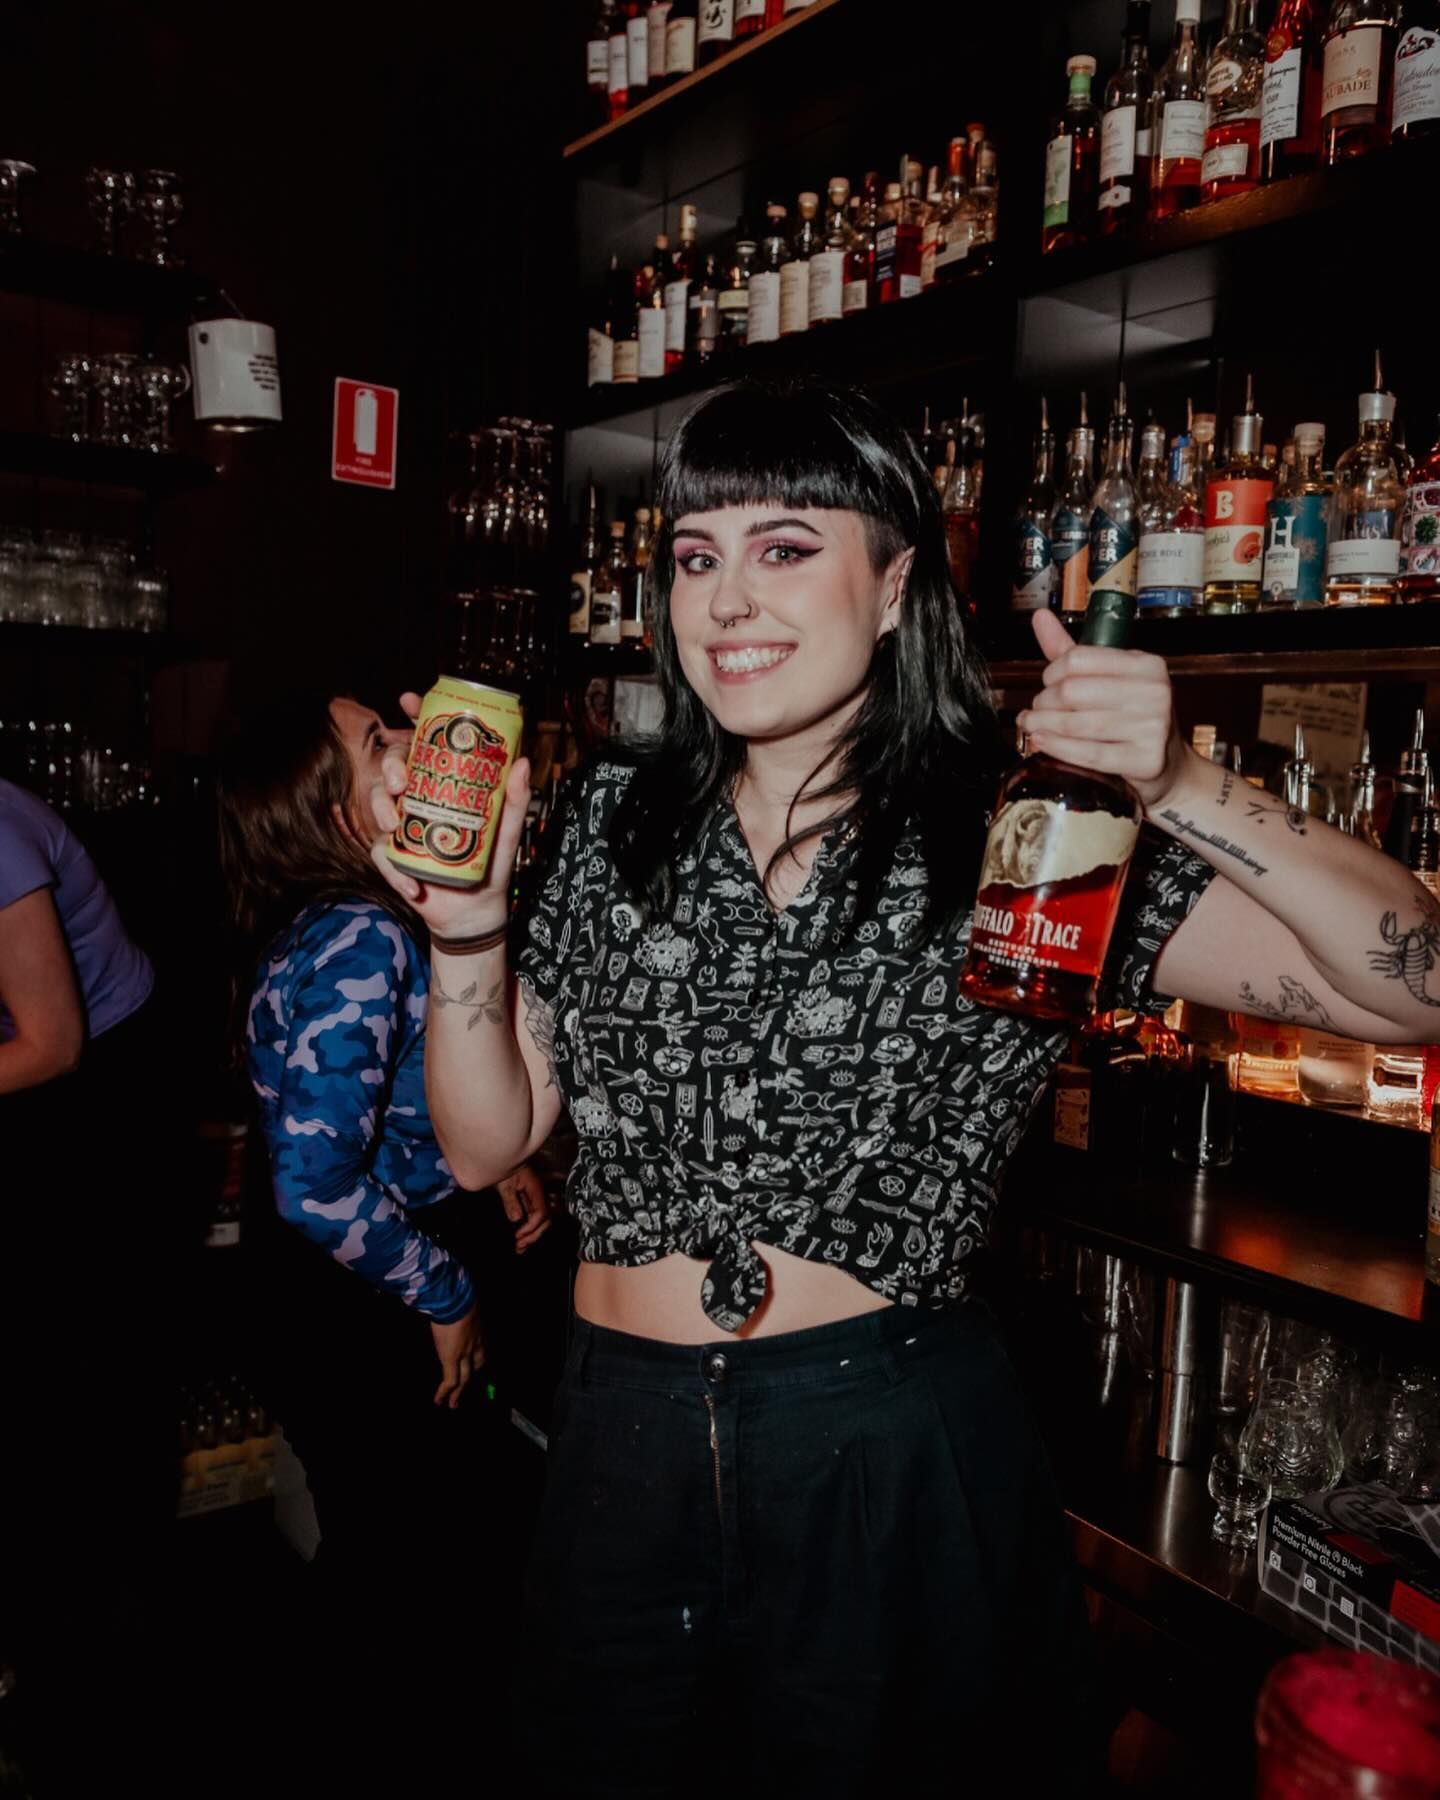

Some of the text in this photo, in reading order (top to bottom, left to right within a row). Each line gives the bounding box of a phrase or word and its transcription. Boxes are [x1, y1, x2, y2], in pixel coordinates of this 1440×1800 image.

[987, 938, 1037, 955] KENTUCKY
[1029, 912, 1082, 951] TRACE
[1271, 1525, 1347, 1578] Powder Free Gloves
[1273, 1514, 1307, 1541] Premium
[1306, 1535, 1332, 1557] Nitrile
[1341, 1556, 1365, 1577] Black
